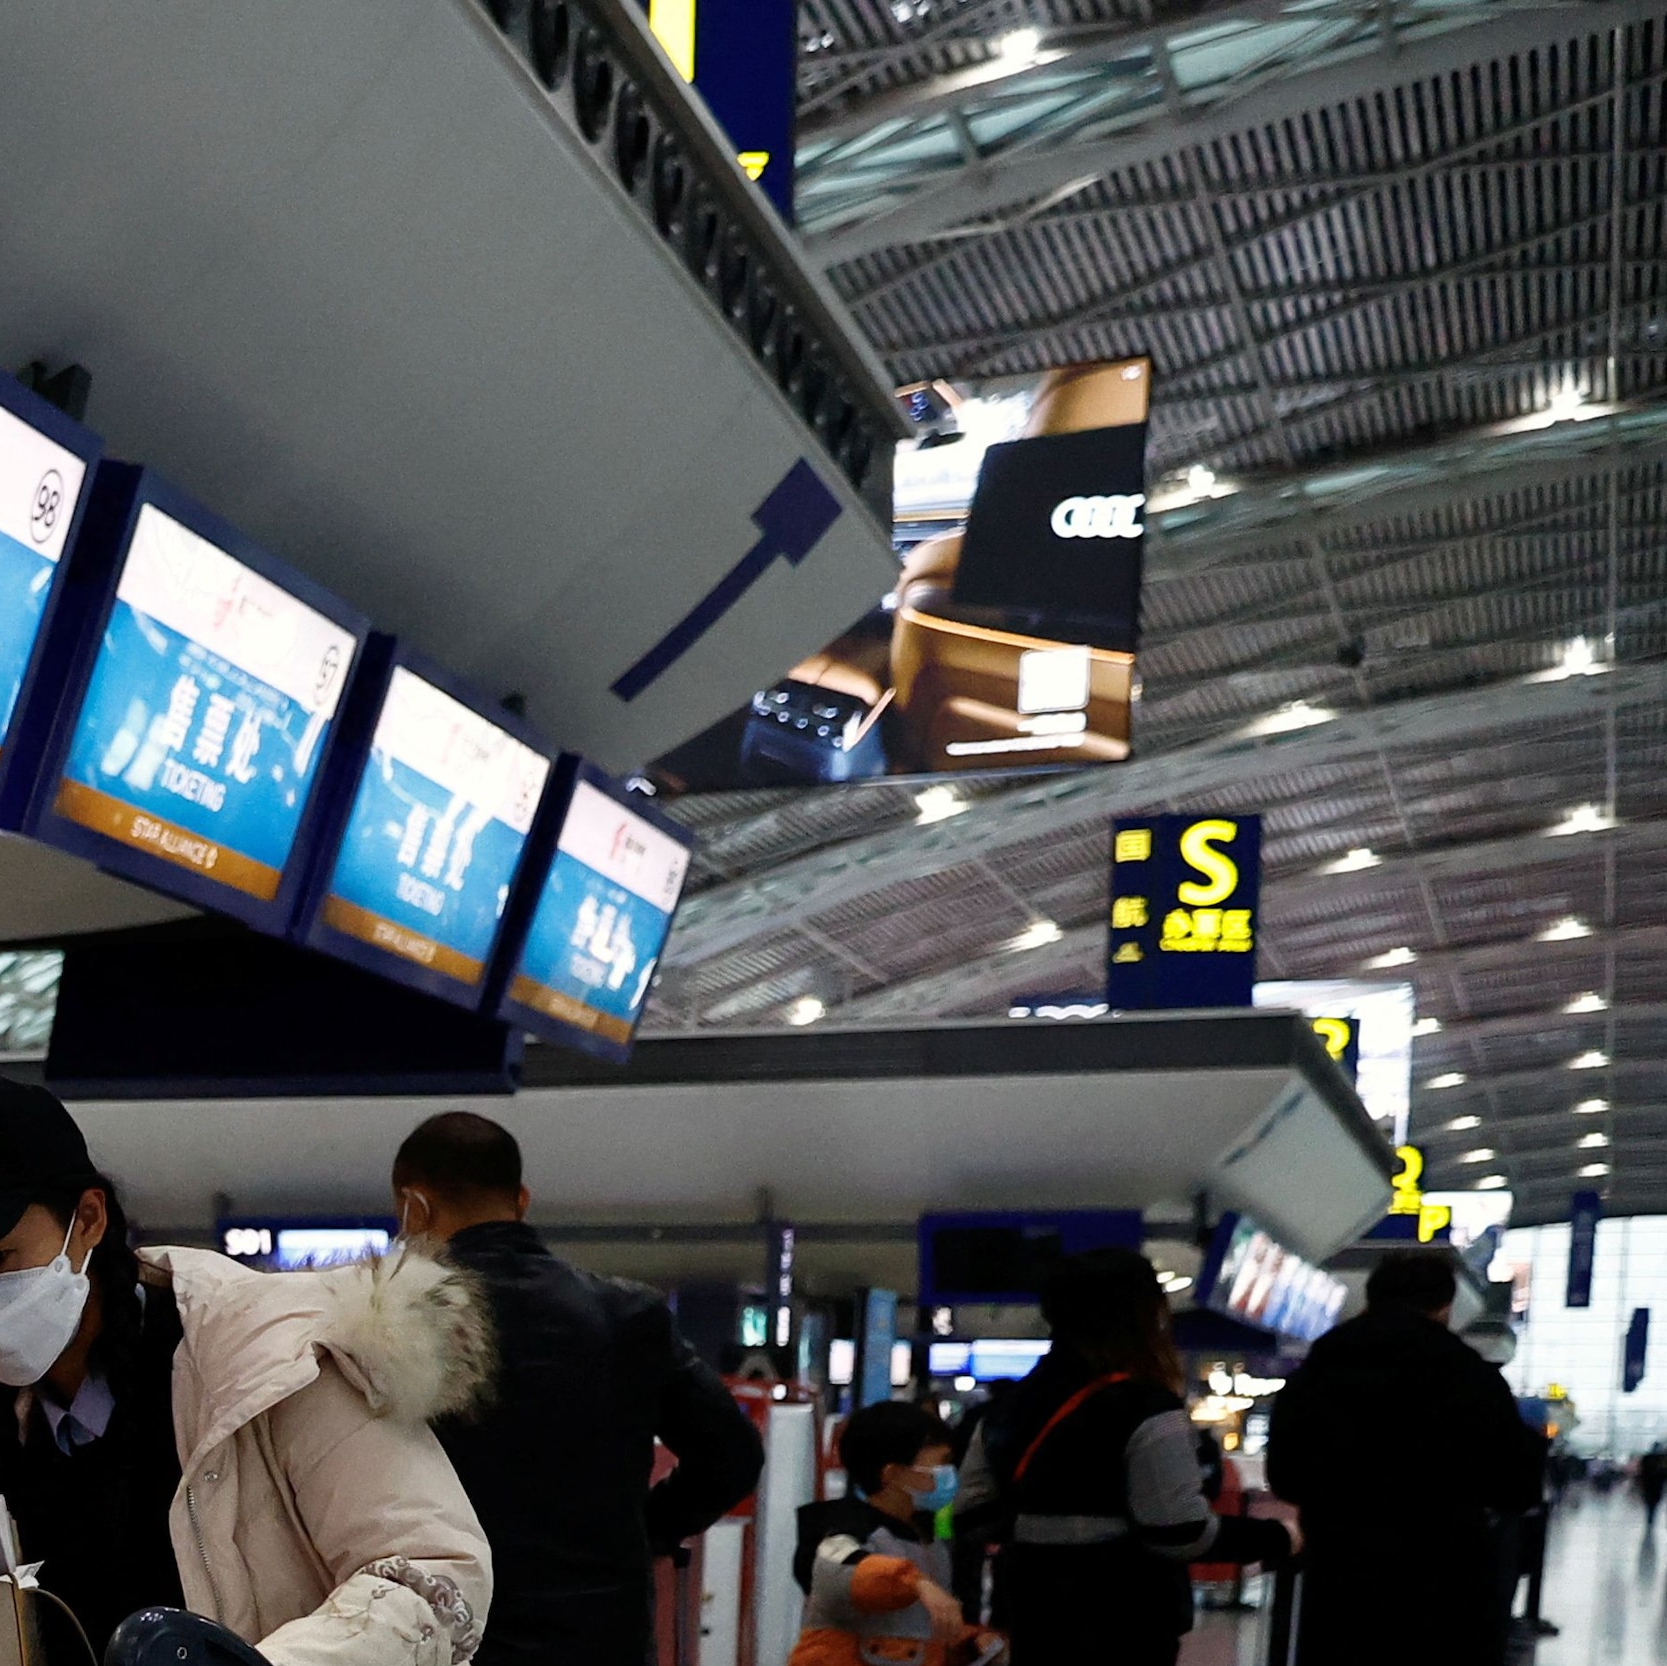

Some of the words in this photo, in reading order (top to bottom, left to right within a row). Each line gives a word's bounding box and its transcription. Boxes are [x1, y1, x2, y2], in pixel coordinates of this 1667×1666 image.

[32, 485, 60, 527] 98
[161, 758, 226, 811] TICKETING
[1179, 820, 1237, 906] S
